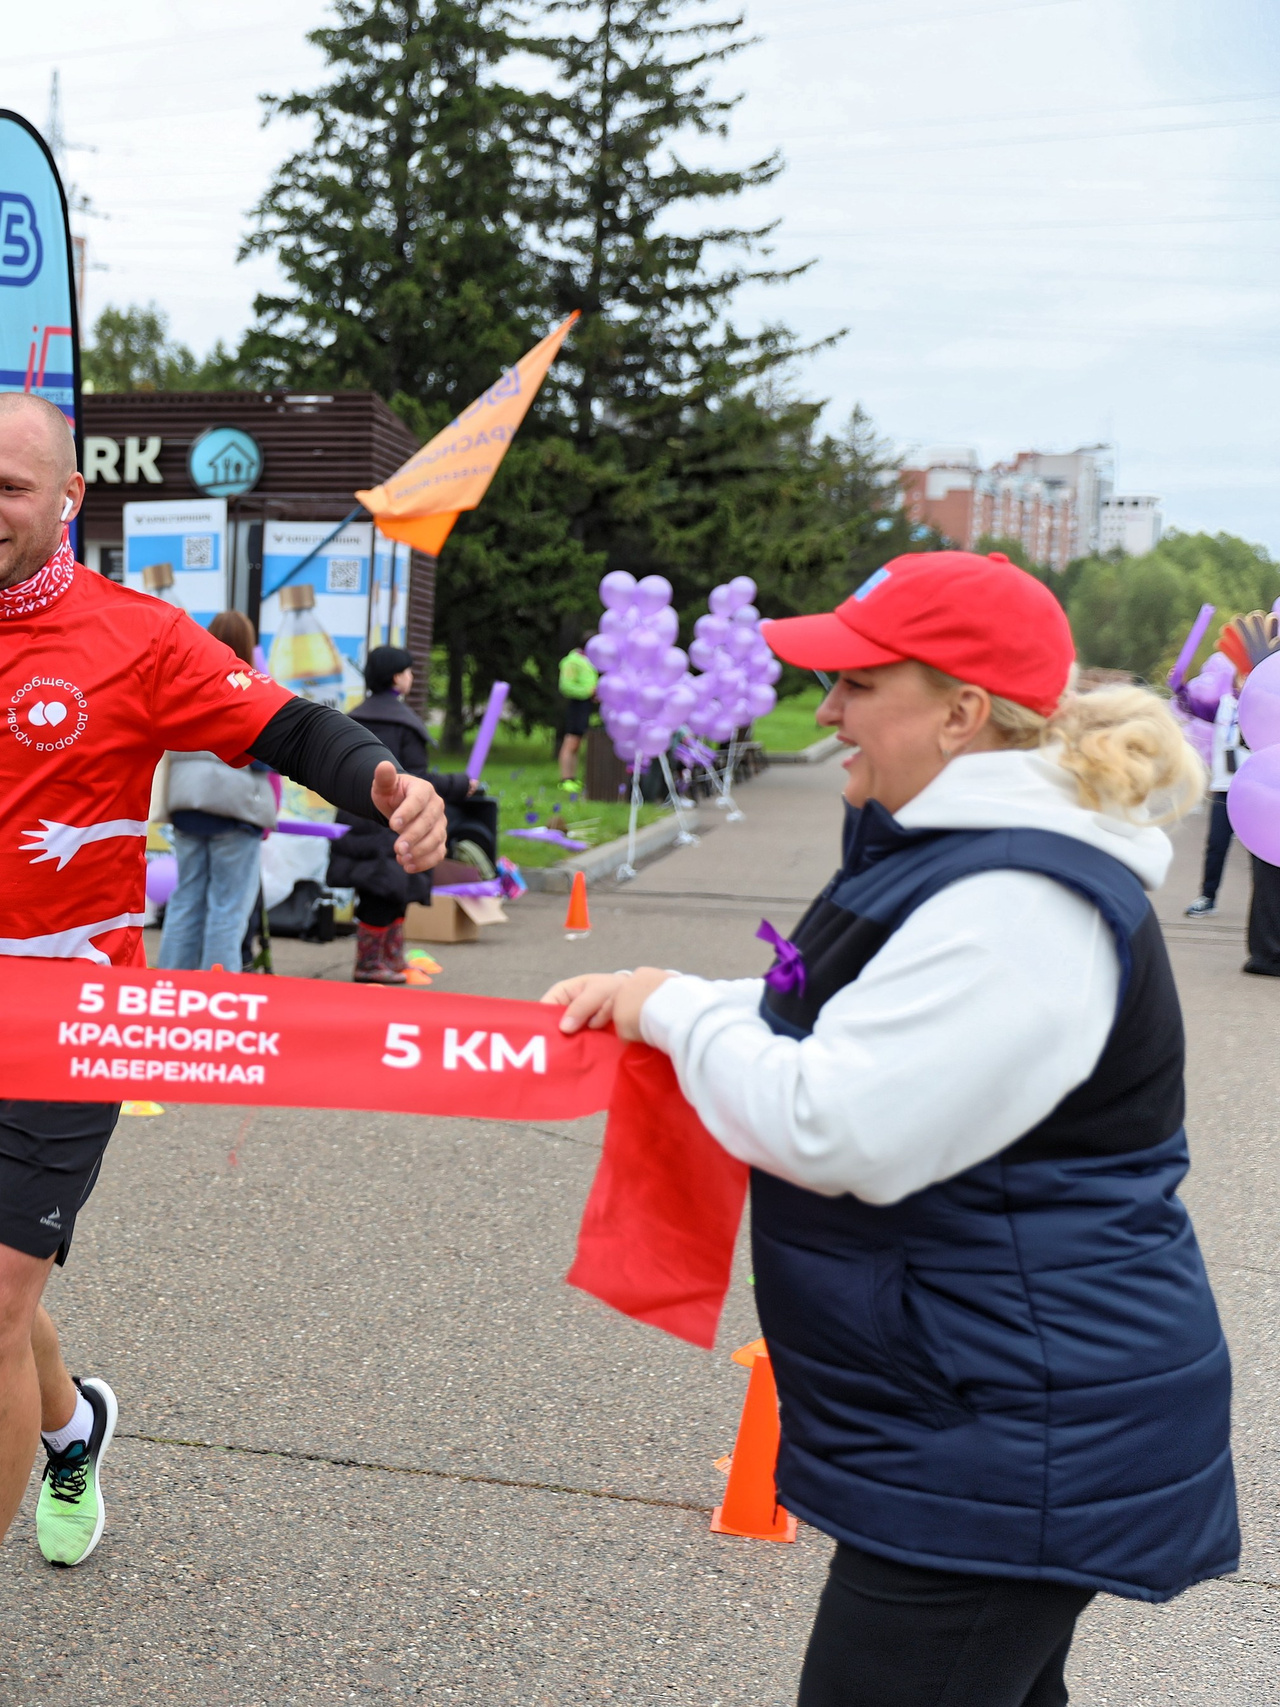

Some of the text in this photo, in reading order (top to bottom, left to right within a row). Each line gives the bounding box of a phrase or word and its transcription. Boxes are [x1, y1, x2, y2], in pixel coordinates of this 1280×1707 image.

[7, 676, 88, 751] сообщество доноров крови
[77, 980, 268, 1021] 5 ВЁРСТ
[58, 1021, 280, 1056] КРАСНОЯРСК
[381, 1022, 547, 1075] 5 КМ
[70, 1057, 265, 1084] НАБЕРЕЖНАЯ
